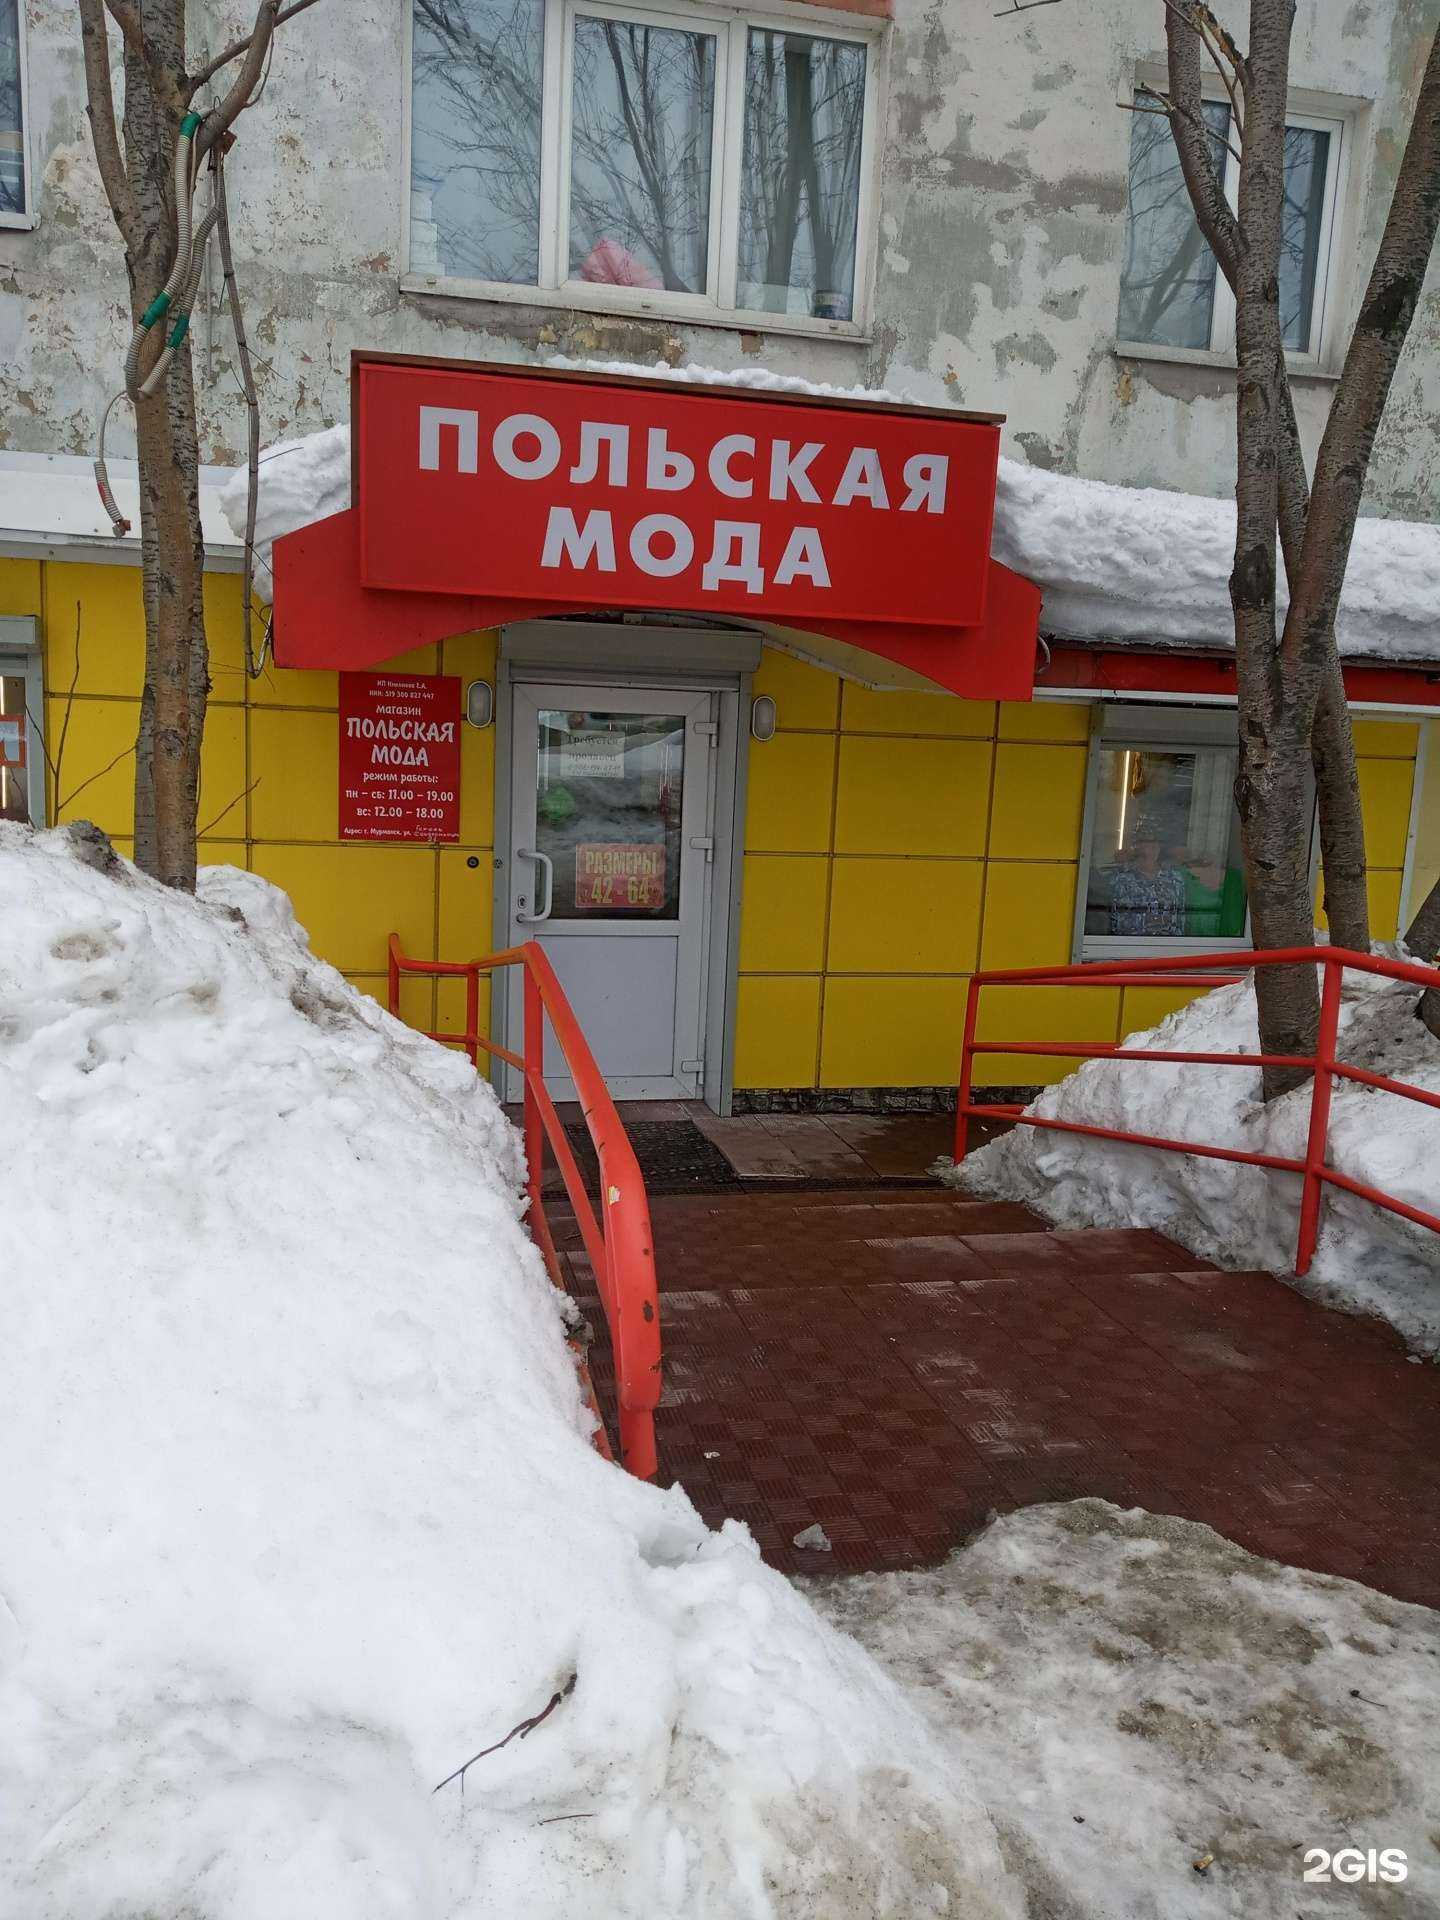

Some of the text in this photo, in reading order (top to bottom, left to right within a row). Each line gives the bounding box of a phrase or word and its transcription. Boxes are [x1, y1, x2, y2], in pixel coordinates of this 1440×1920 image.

[419, 405, 949, 514] ПОЛЬСКАЯ
[540, 506, 832, 594] МОДА
[376, 705, 421, 715] магазин
[347, 717, 455, 743] ПОЛЬСКАЯ
[371, 744, 429, 767] МОДА
[363, 772, 439, 784] режим работы:
[388, 789, 413, 800] 11.00
[426, 791, 454, 802] 19.00
[374, 806, 403, 817] 12.00
[416, 808, 444, 819] 18.00
[584, 851, 657, 874] РАЗМЕРЫ
[591, 876, 613, 904] 42
[627, 876, 650, 904] 64
